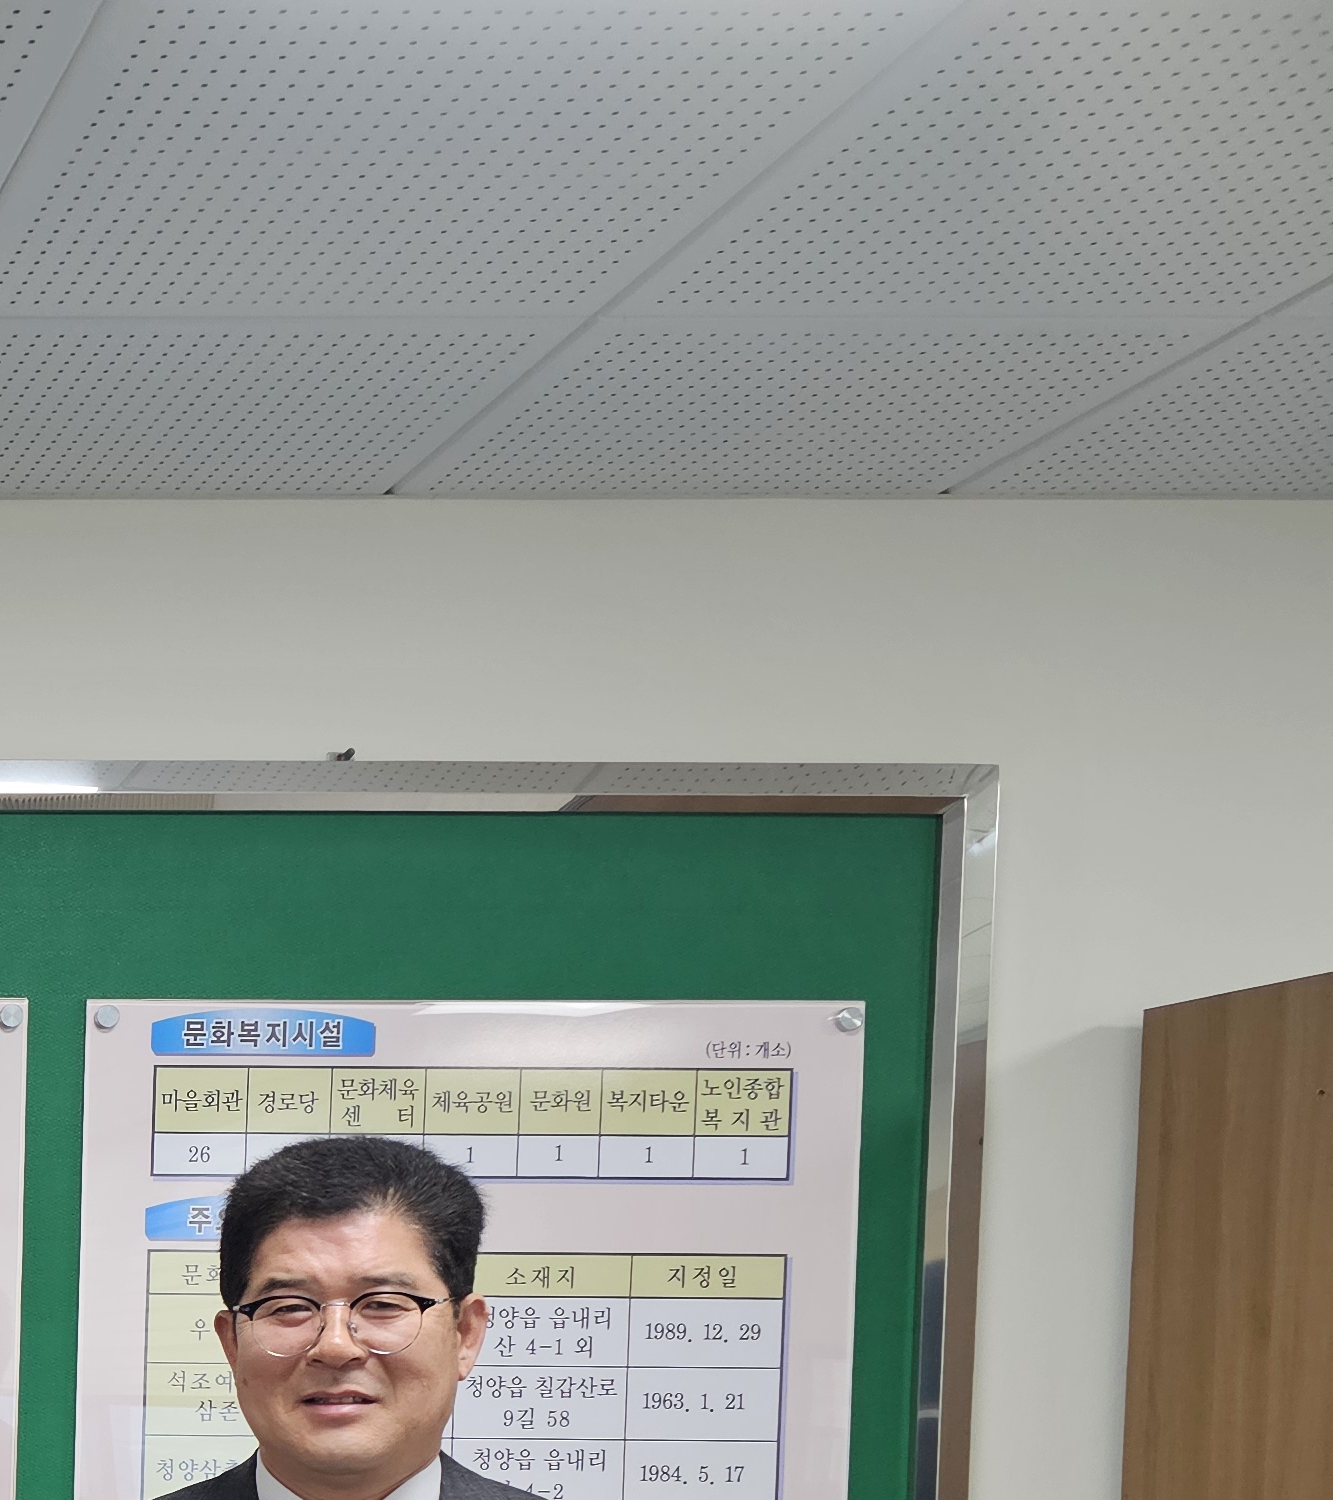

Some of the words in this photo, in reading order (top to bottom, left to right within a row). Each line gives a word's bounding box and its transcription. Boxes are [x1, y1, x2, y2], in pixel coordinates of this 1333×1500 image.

[182, 1019, 343, 1049] 문화복지시설
[161, 1088, 244, 1113] 마을회관
[257, 1090, 320, 1115] 경로당
[336, 1077, 420, 1102] 문화체육
[431, 1090, 514, 1114] 체육공원
[529, 1089, 592, 1113] 문화원
[606, 1089, 690, 1114] 복지타운
[700, 1076, 785, 1101] 노인종합
[188, 1145, 211, 1163] 26
[554, 1144, 563, 1162] 1
[644, 1146, 653, 1164] 1
[740, 1147, 749, 1166] 1
[505, 1265, 575, 1290] 소재지
[667, 1264, 737, 1289] 지정일
[548, 1306, 611, 1331] 읍내리
[493, 1334, 517, 1358] 산
[525, 1338, 563, 1356] 4-1
[573, 1335, 593, 1359] 외
[644, 1322, 693, 1343] 1989.
[703, 1323, 728, 1344] 12.
[738, 1323, 762, 1341] 29
[463, 1373, 528, 1399] 청양읍
[534, 1375, 618, 1399] 칠갑산로
[503, 1407, 535, 1430] 9길
[547, 1410, 570, 1428] 58
[642, 1392, 690, 1413] 1963.
[700, 1393, 714, 1413] 1.
[724, 1393, 745, 1410] 21
[471, 1447, 536, 1474] 청양읍
[543, 1448, 606, 1472] 읍내리
[639, 1464, 688, 1485] 1984.
[698, 1465, 715, 1486] 5.
[724, 1465, 745, 1483] 17
